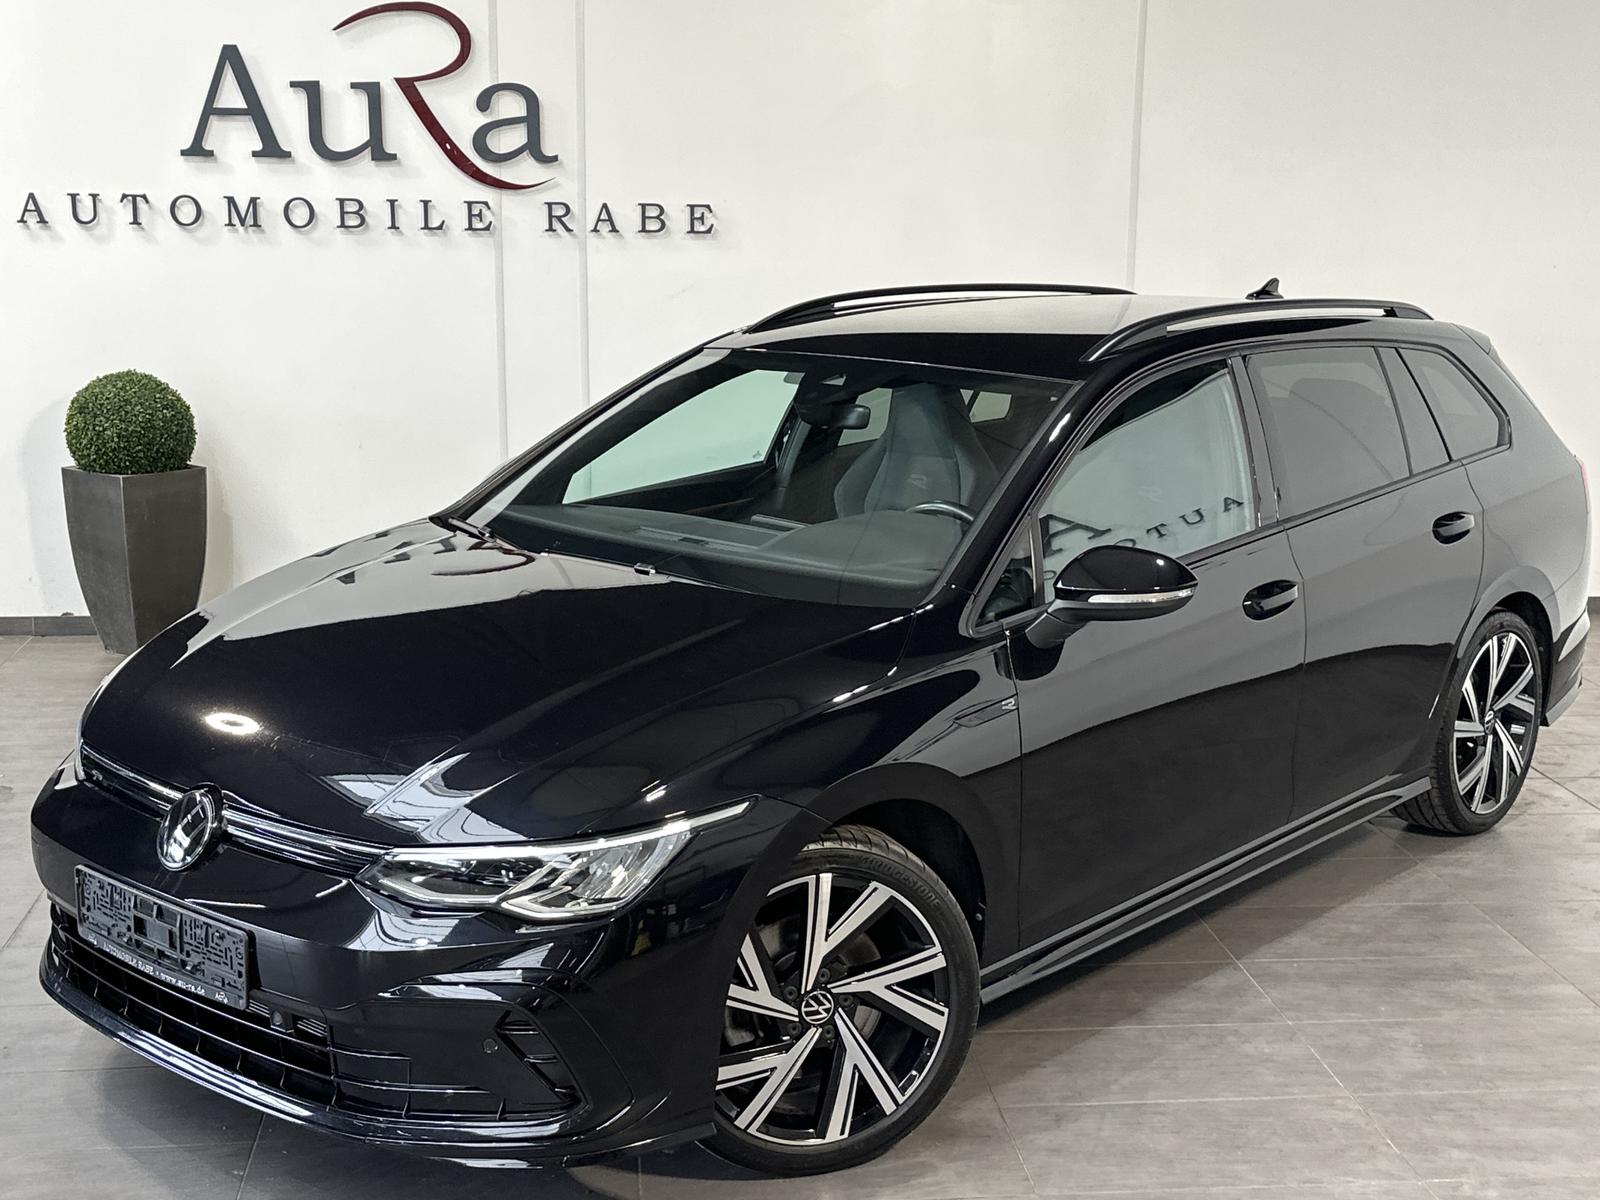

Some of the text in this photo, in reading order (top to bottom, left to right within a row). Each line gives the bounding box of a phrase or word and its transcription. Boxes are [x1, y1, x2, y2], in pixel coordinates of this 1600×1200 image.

[181, 2, 558, 190] AuRa
[18, 193, 713, 234] AUTOMOBILE RABE
